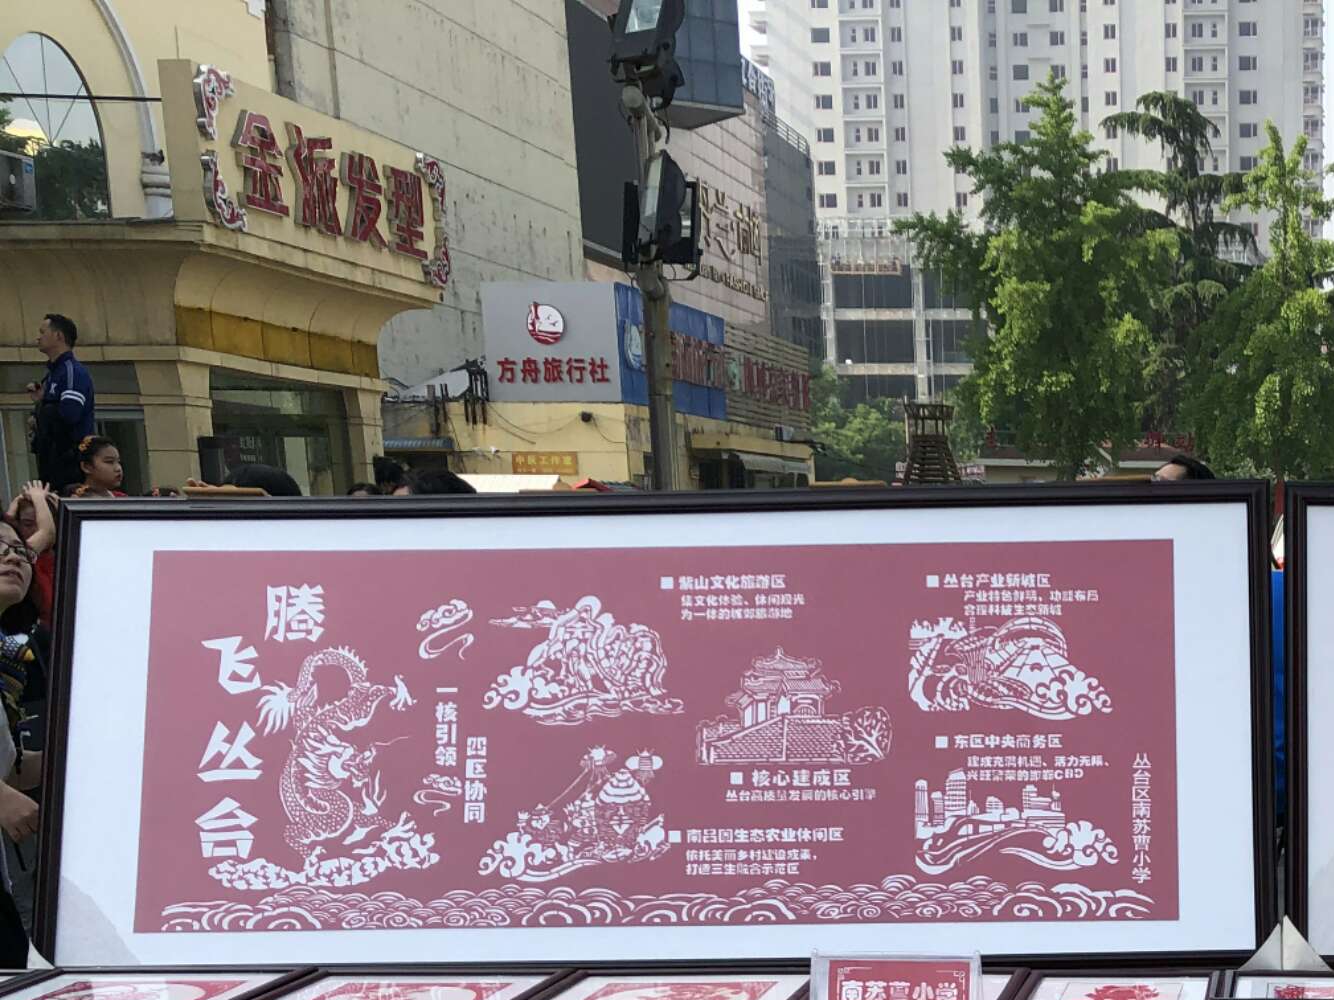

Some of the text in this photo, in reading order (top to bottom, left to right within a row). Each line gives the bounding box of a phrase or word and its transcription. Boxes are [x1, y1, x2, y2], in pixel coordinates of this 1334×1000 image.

[233, 109, 429, 260] 金派发型
[497, 357, 610, 384] 方舟旅行社
[434, 687, 458, 767] 一核引领
[954, 734, 1063, 749] 东区中央商务区
[463, 736, 487, 824] 四区协同
[751, 769, 852, 787] 核心建成区
